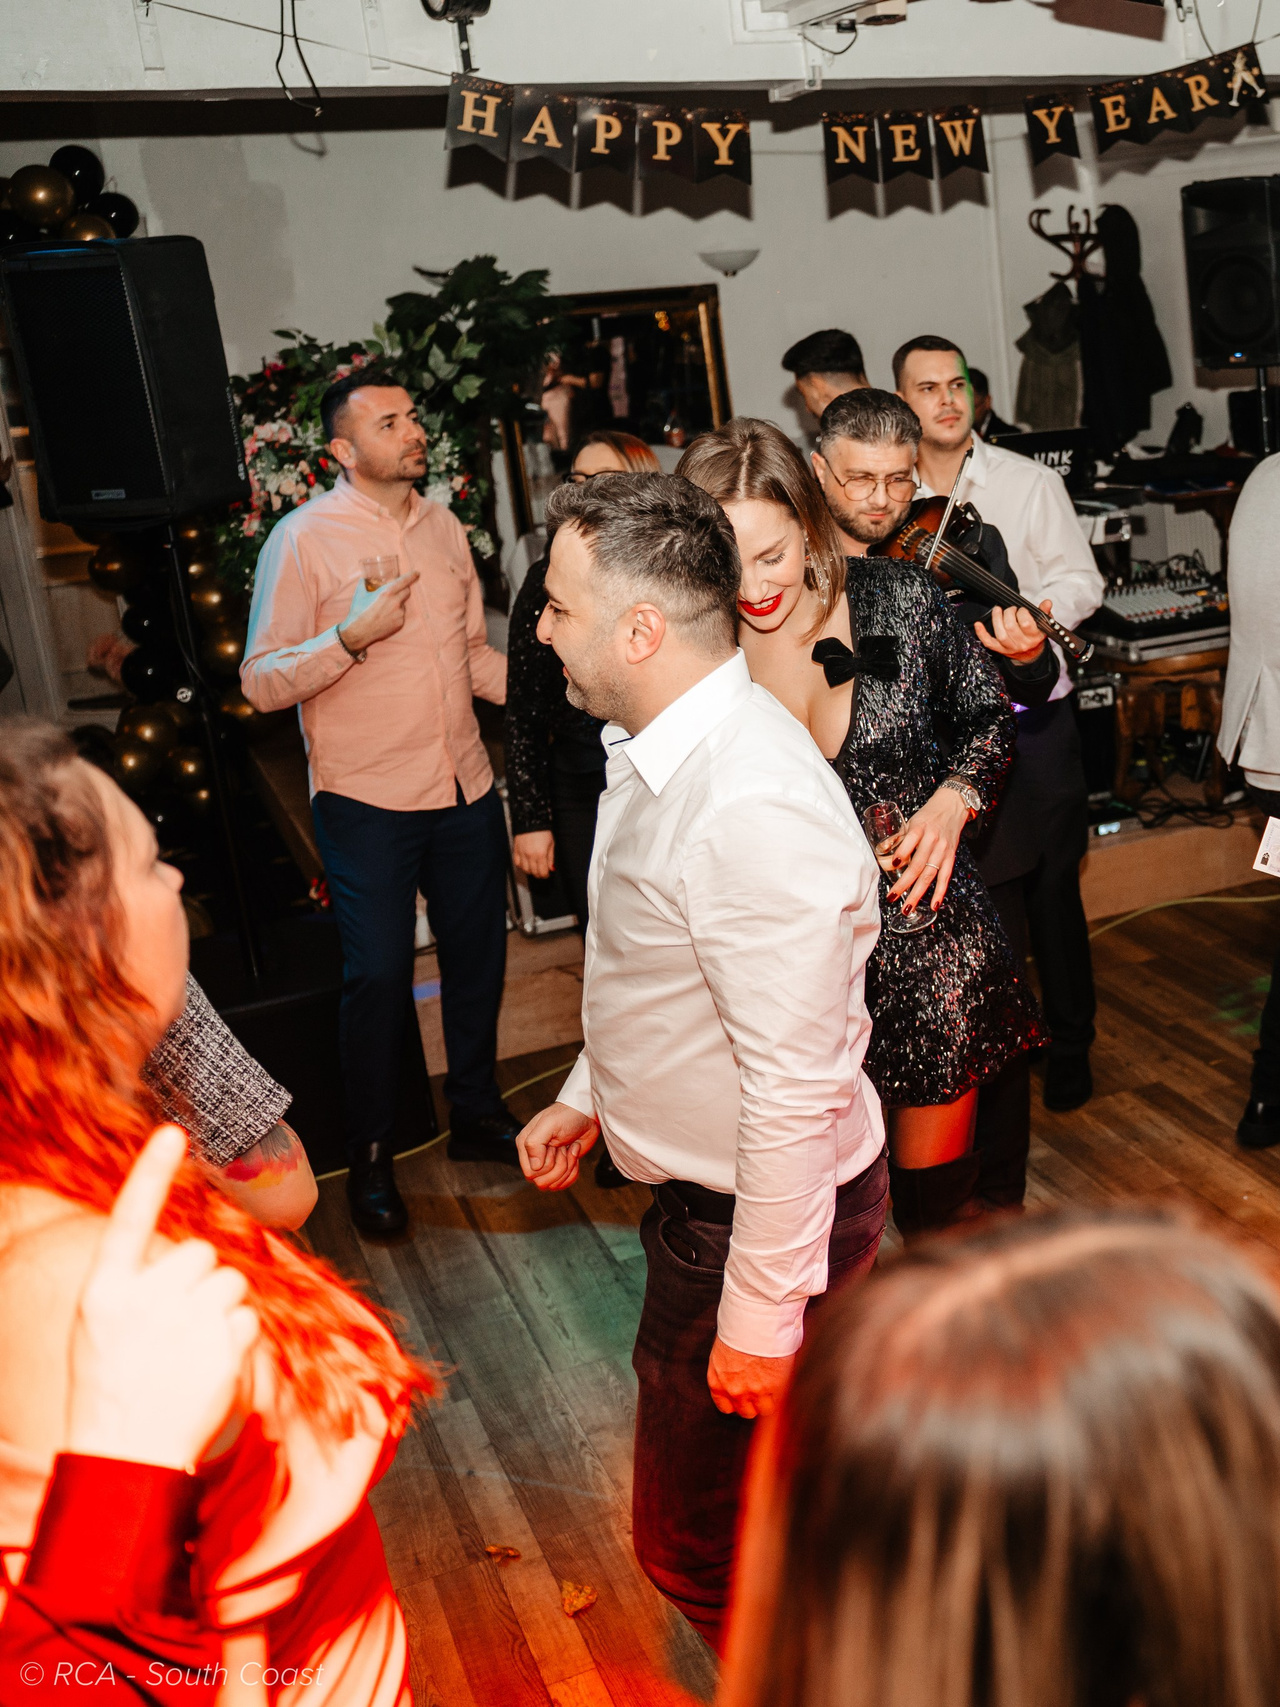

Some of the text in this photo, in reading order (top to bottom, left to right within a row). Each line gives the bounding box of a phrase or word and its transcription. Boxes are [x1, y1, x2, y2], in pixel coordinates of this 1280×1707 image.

[456, 73, 1220, 166] HAPPY NEW YEAR
